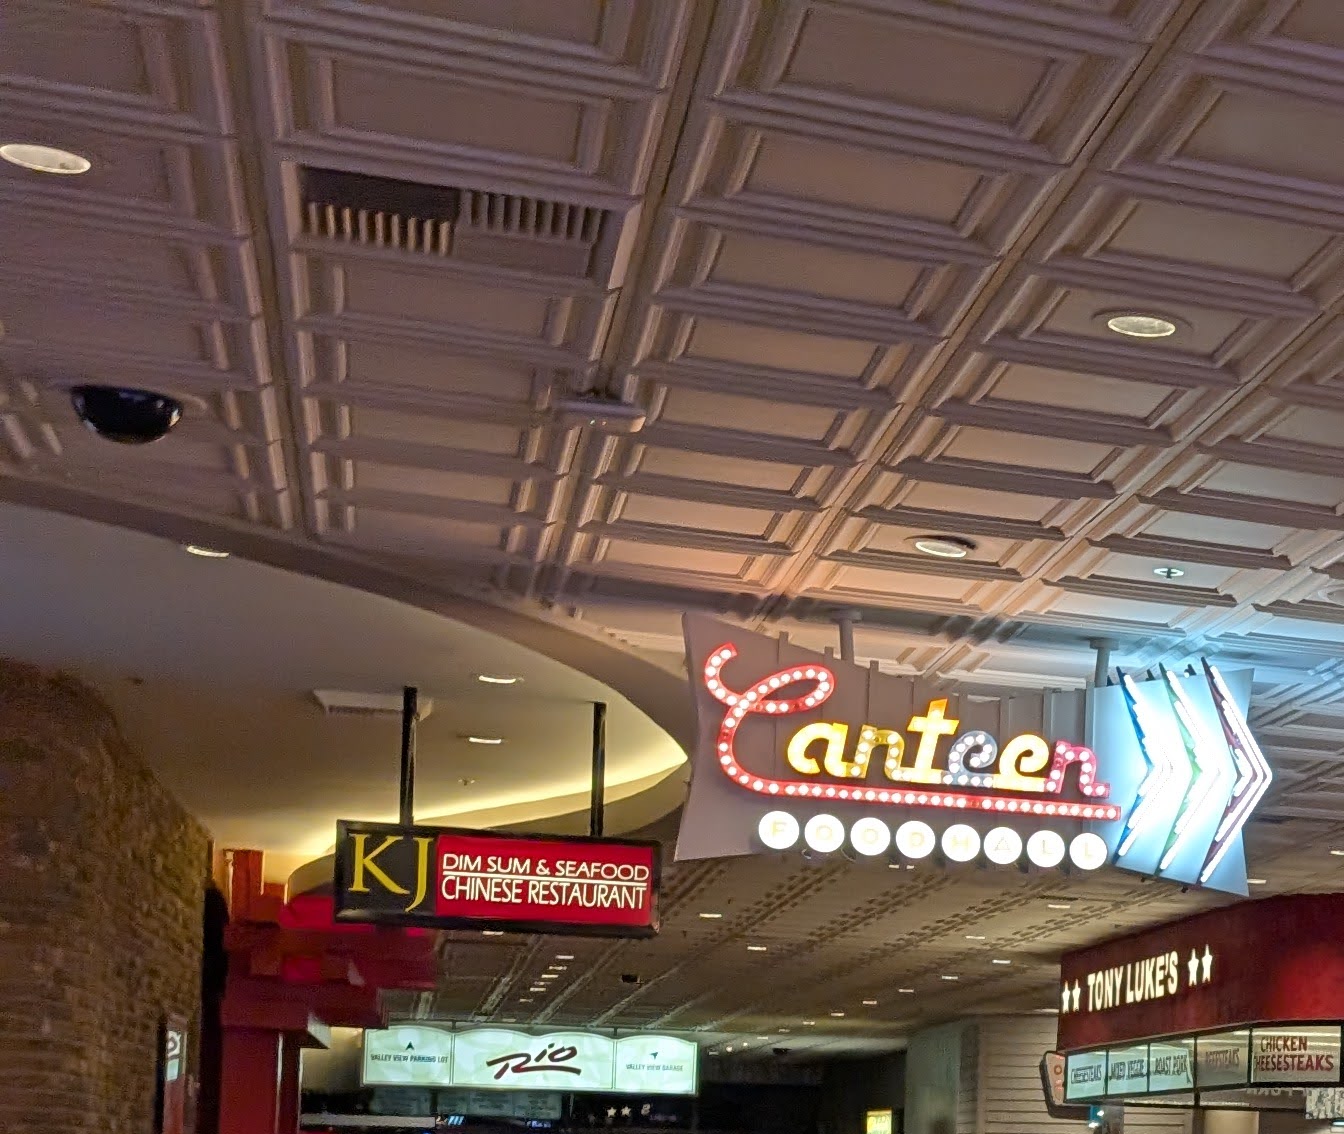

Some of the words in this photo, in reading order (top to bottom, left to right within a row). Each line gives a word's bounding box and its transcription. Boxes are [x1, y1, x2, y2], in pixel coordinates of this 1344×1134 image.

[704, 643, 1121, 820] Canteen
[349, 834, 434, 912] KJ
[443, 854, 482, 871] DIM
[487, 856, 531, 874] SUM
[536, 859, 551, 876] &
[555, 860, 650, 881] SEAFOOD
[441, 876, 523, 903] CHINESE
[528, 881, 647, 909] RESTAURANT
[1087, 966, 1124, 1012] TONY
[1125, 951, 1179, 1004] LUKE'S
[1260, 1036, 1307, 1053] CHICKEN
